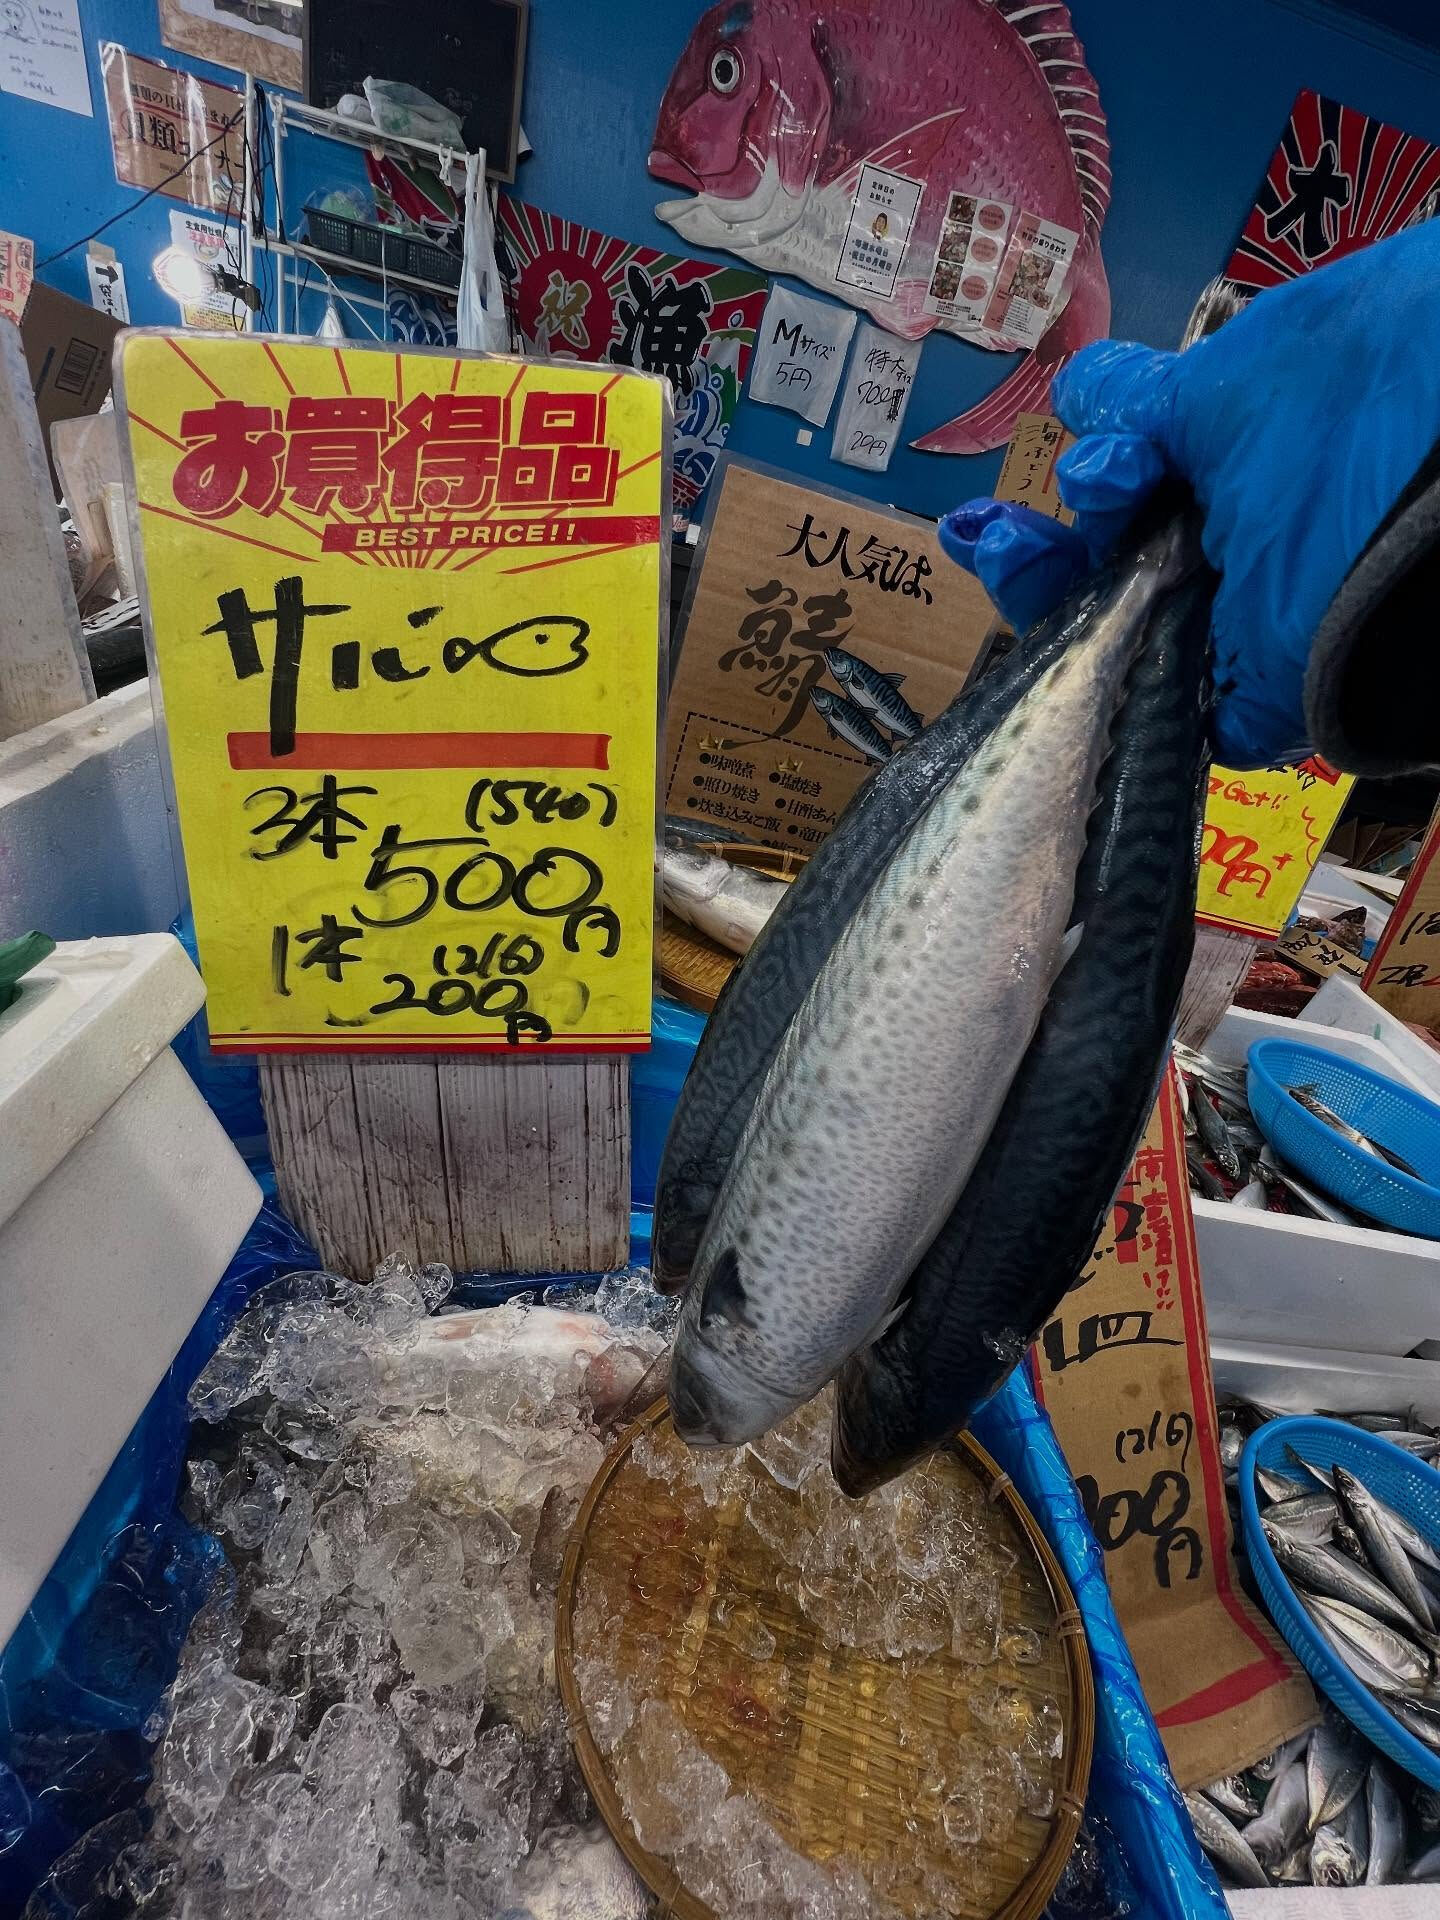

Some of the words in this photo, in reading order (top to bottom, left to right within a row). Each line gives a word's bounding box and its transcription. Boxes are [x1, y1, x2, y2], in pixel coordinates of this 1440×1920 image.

[1263, 141, 1352, 261] 大
[775, 362, 812, 392] 5円
[172, 391, 621, 519] お買得品
[850, 430, 888, 456] 20円
[355, 527, 441, 548] BEST
[449, 523, 576, 546] PRICE!!
[242, 774, 379, 862] 3本
[465, 778, 619, 832] (540)
[697, 797, 783, 833] 炊き込みご飯
[272, 914, 364, 998] 1本
